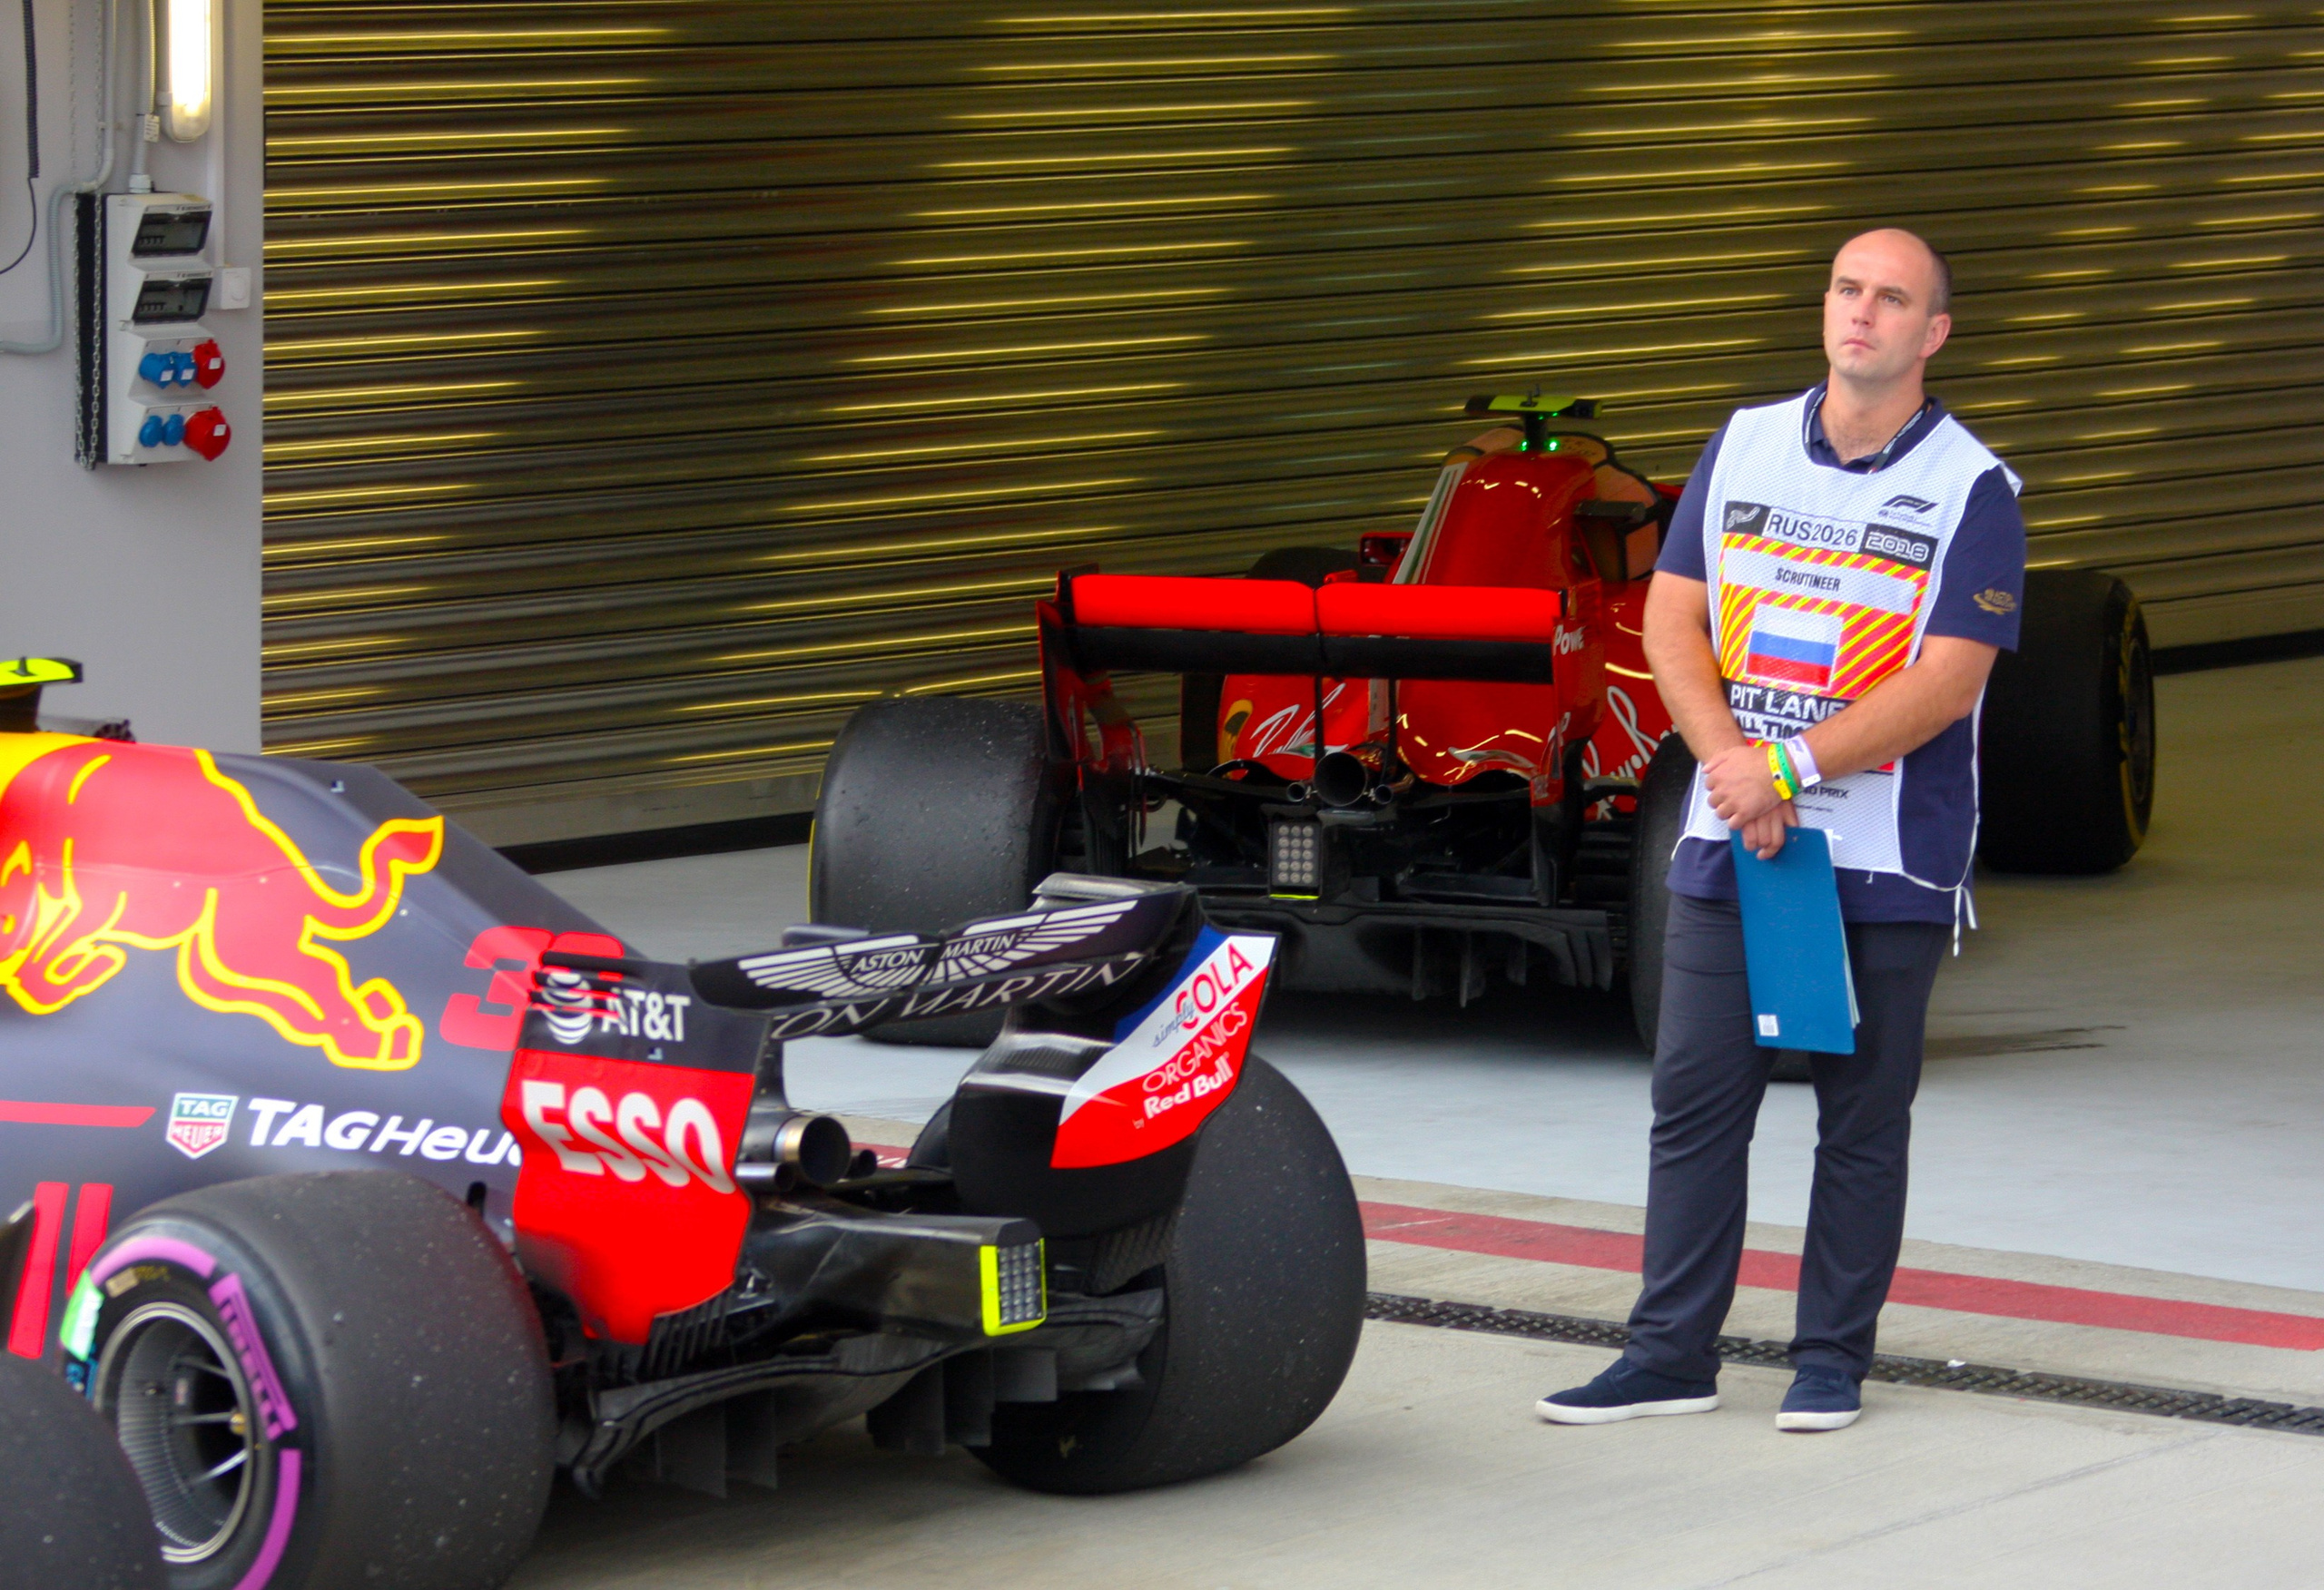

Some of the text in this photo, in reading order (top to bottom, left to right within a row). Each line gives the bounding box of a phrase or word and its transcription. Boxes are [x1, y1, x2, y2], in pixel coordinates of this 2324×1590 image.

[1865, 531, 1930, 563] 2018
[1775, 567, 1842, 593] SCRUTINEER
[1730, 683, 1763, 710] PIT
[850, 932, 1015, 974] ASTON MARTIN
[899, 951, 1146, 1018] MARTIN
[1151, 941, 1256, 1048] simply COLA
[600, 986, 692, 1042] AT&T
[1141, 1001, 1248, 1093] ORGANICS
[180, 1099, 231, 1118] TAG
[1142, 1082, 1191, 1120] Red
[1192, 1054, 1234, 1098] Bull
[171, 1124, 222, 1150] HEUER
[520, 1079, 736, 1195] ESSO
